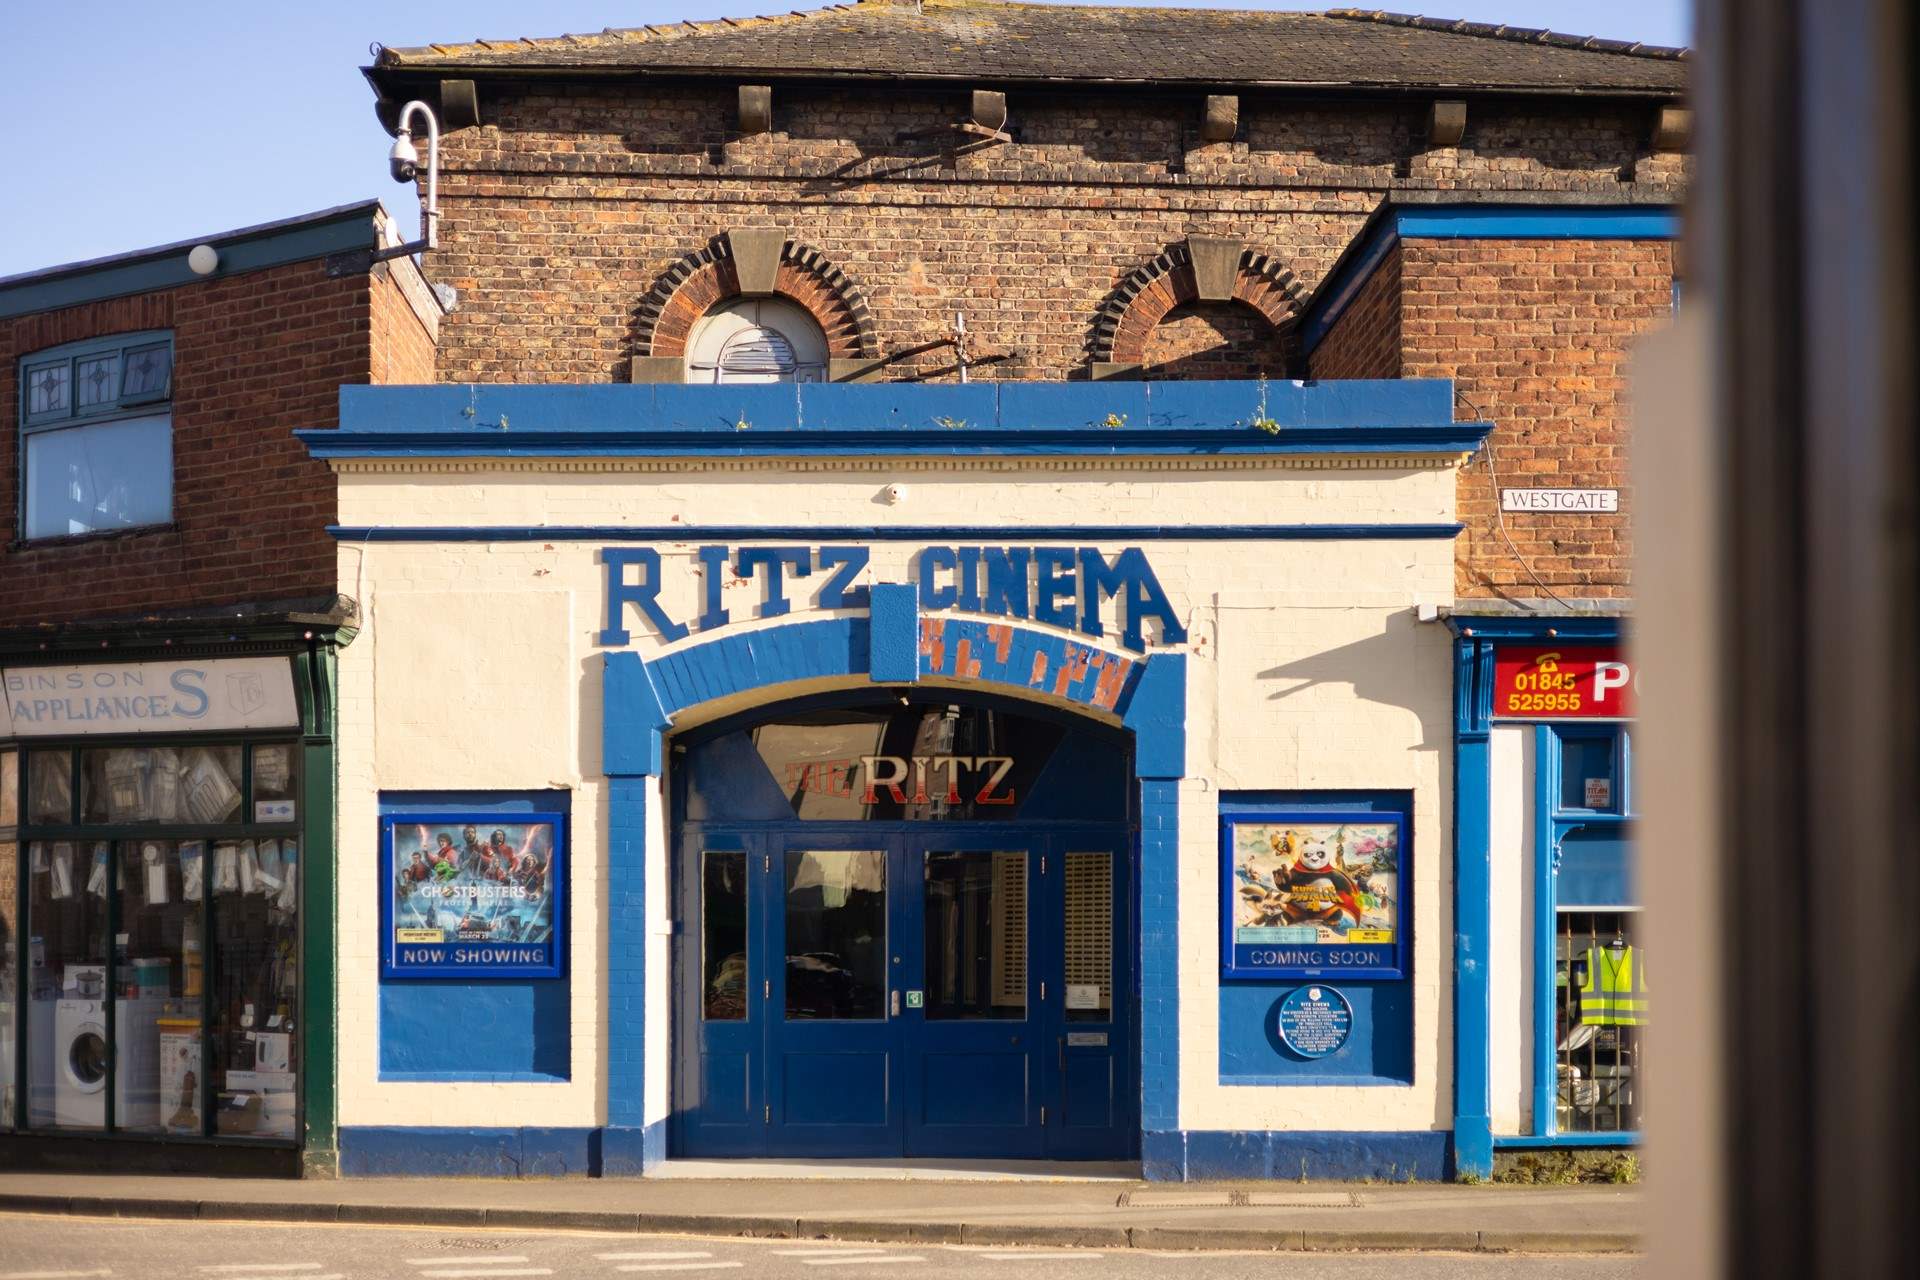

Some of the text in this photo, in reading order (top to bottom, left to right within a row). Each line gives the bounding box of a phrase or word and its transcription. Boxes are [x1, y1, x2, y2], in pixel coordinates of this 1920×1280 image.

[1511, 492, 1609, 509] WESTGATE
[599, 545, 1188, 654] RITZ CINEMA
[0, 670, 144, 692] BINSON
[1515, 673, 1576, 691] 01845
[1593, 661, 1641, 702] P
[1508, 694, 1581, 711] 525955
[784, 755, 1016, 805] THE RITZ
[420, 885, 527, 899] GHOSTBUSTERS
[403, 949, 545, 964] NOW SHOWING
[1250, 951, 1381, 965] COMING SOON
